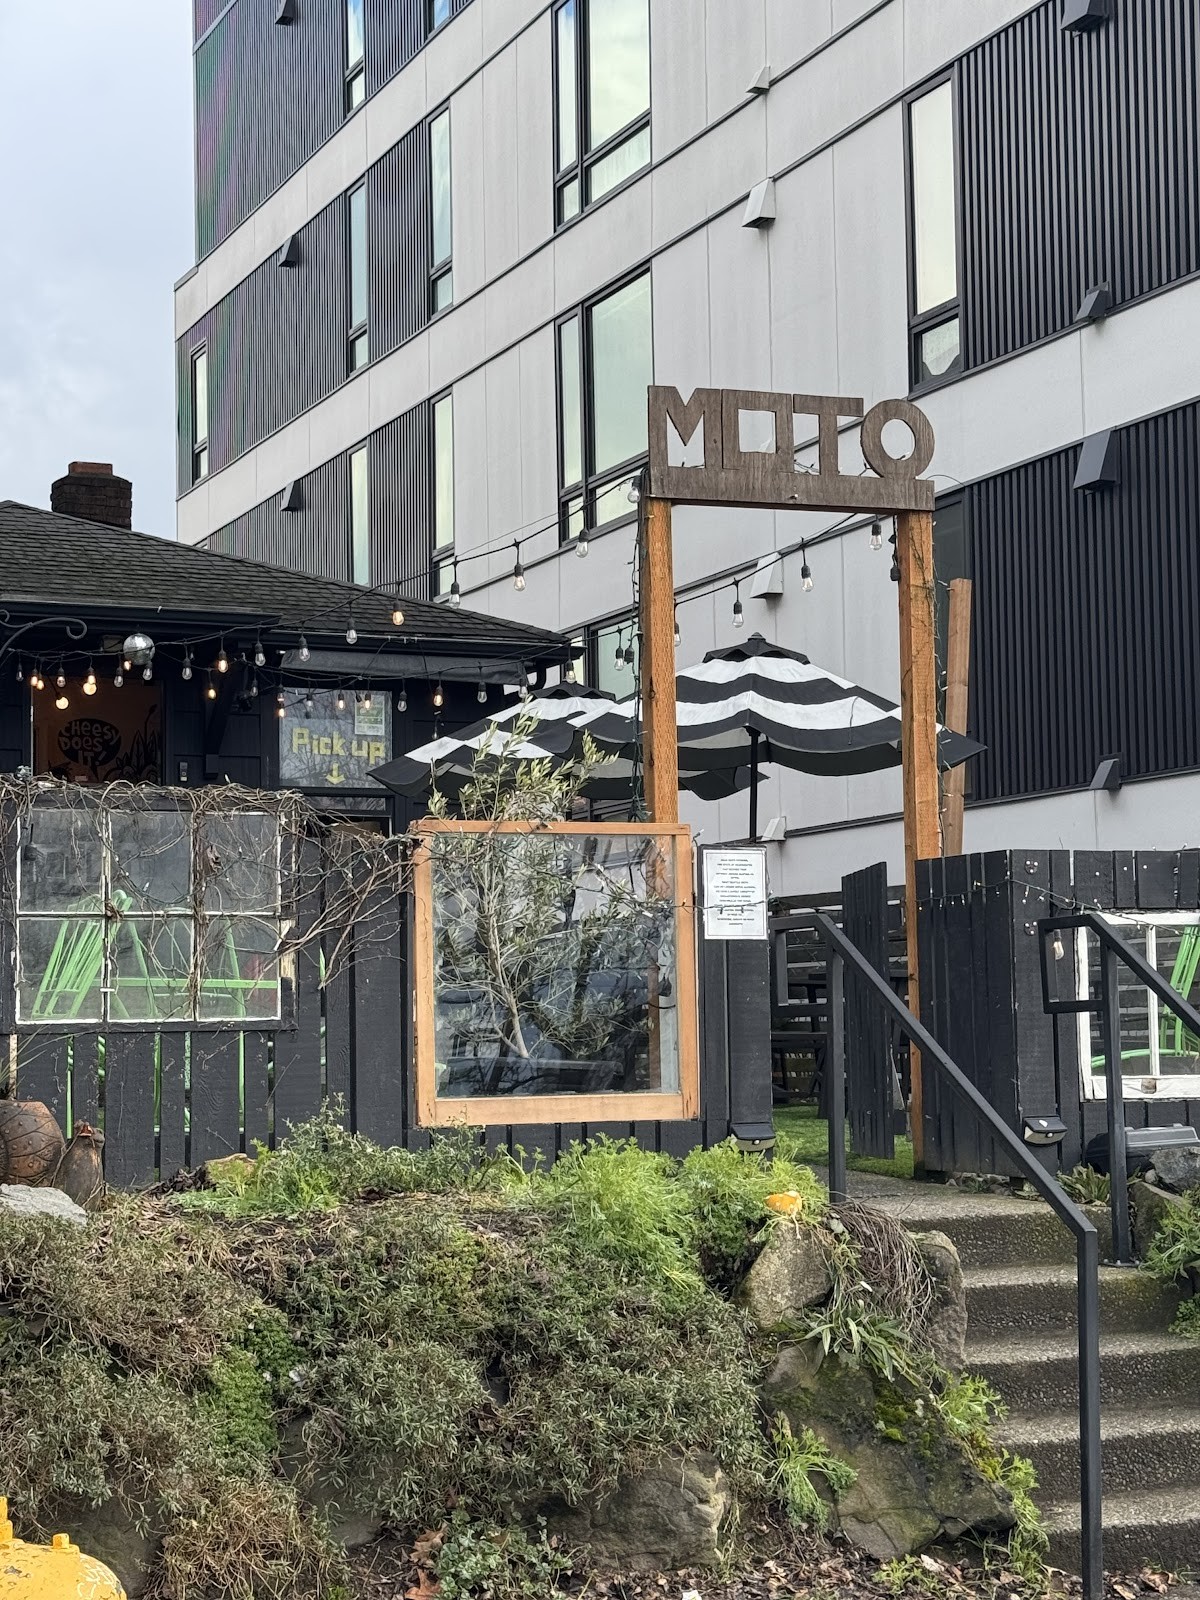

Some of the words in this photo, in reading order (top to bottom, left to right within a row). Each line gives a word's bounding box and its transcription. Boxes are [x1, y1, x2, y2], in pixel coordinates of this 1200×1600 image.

[648, 386, 935, 480] MOTO
[292, 727, 346, 756] Pick
[78, 750, 107, 766] IT!
